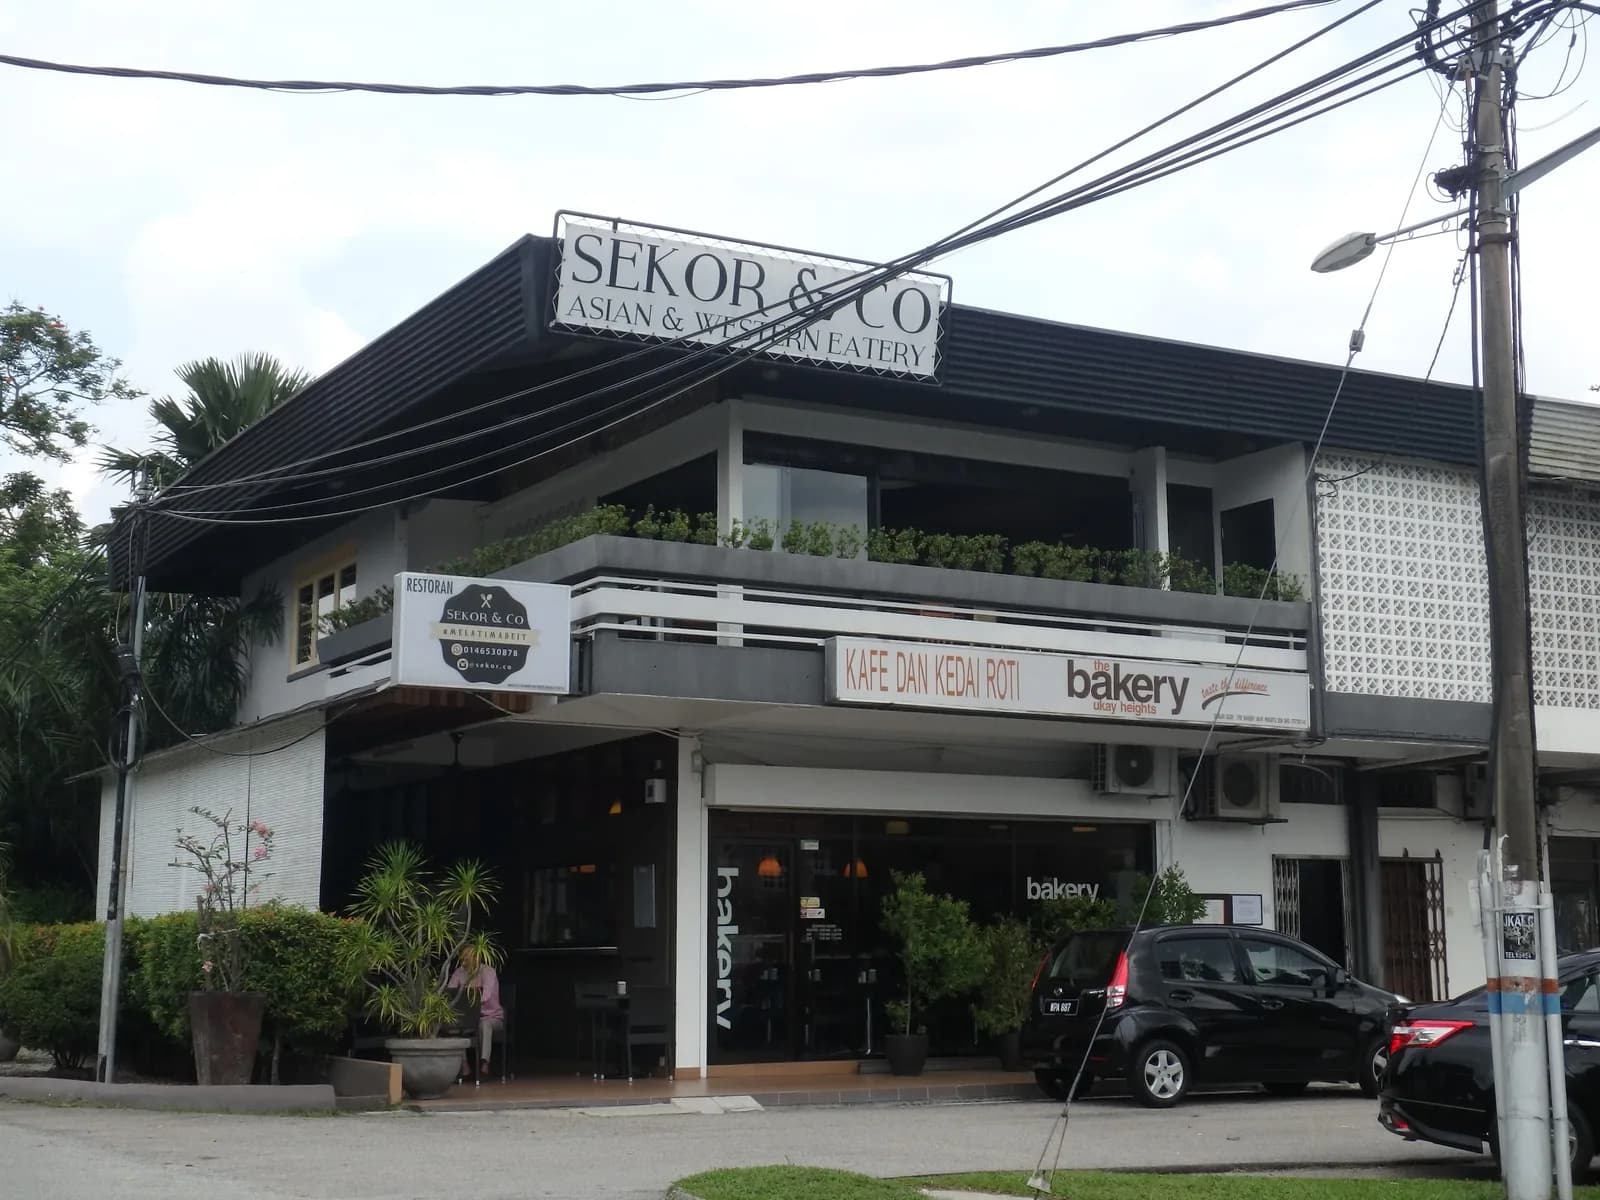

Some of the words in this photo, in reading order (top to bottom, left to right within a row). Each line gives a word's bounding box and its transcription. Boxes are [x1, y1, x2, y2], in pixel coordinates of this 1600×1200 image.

[572, 233, 768, 318] SEKOR
[788, 267, 833, 321] &
[854, 279, 932, 334] CO
[567, 295, 653, 328] ASIAN
[662, 306, 684, 332] &
[695, 311, 821, 352] WESTERN
[827, 331, 926, 367] EATERY
[406, 577, 454, 595] RESTORAN
[447, 609, 488, 623] SEKOR
[492, 612, 502, 624] &
[846, 648, 889, 692] KAFE
[896, 651, 928, 695] DAN
[935, 654, 980, 698] KEDAI
[986, 658, 1020, 701] ROTI
[1094, 659, 1110, 672] the
[1067, 659, 1190, 715] bakery
[1093, 701, 1117, 715] ukay
[1120, 703, 1157, 716] heights
[1026, 876, 1099, 904] bakery
